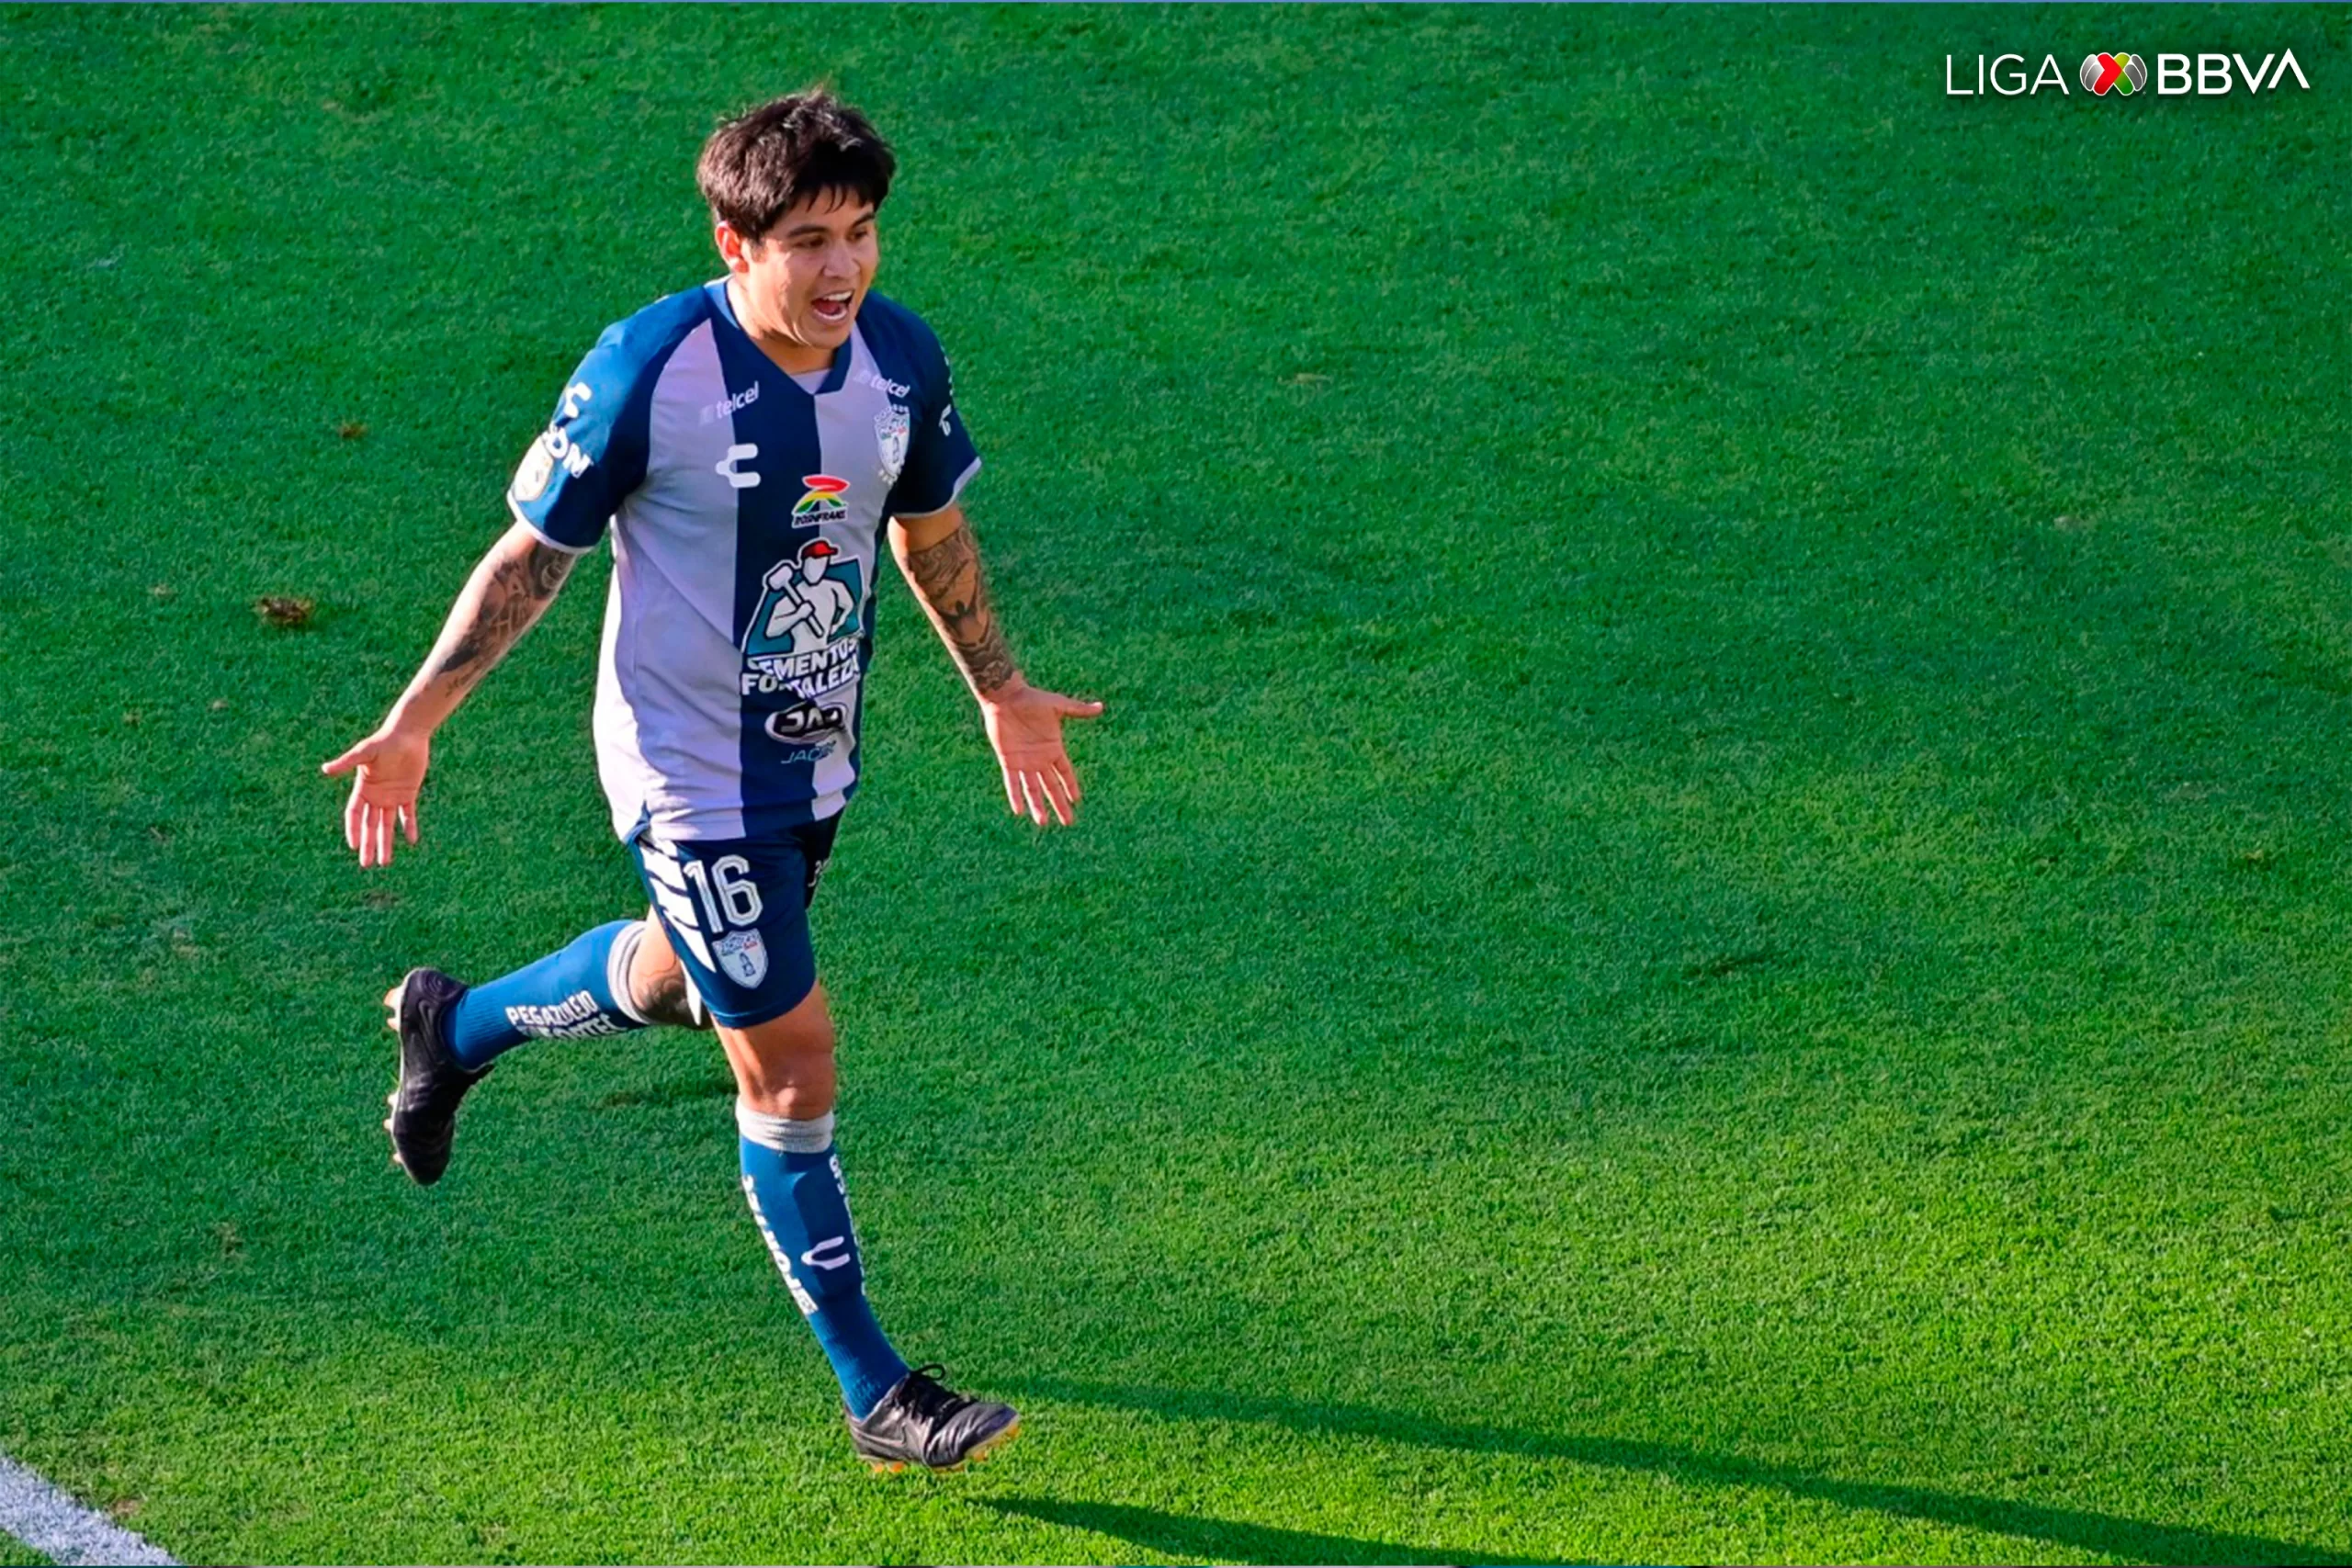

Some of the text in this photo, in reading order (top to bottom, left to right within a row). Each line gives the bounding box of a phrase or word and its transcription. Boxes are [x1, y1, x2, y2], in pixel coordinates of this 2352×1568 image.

[716, 378, 760, 420] telcel
[870, 373, 910, 399] telcel
[741, 653, 861, 699] FOTALEZA
[683, 853, 763, 933] 16
